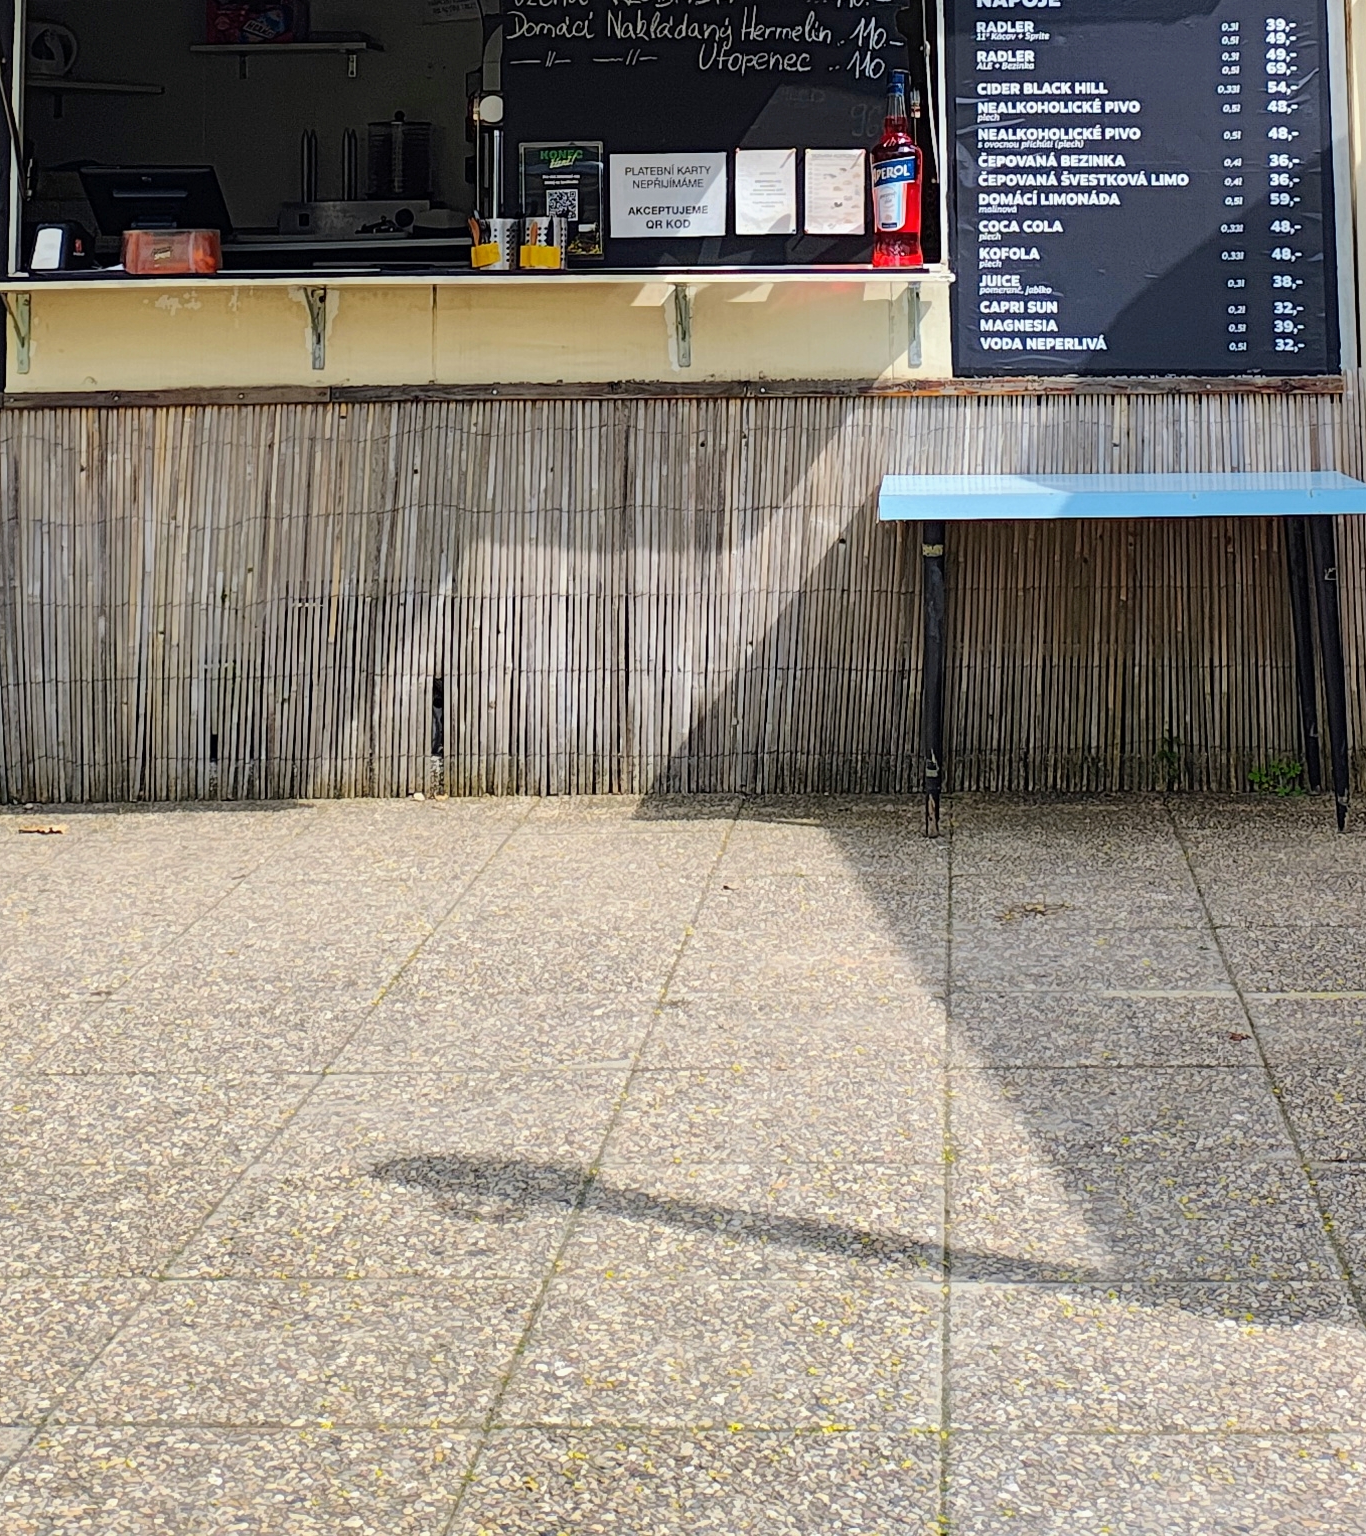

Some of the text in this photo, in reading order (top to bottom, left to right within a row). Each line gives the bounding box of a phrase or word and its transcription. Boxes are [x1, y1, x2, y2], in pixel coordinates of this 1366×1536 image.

[507, 11, 594, 39] Domácí
[607, 9, 732, 49] Nakládaný
[976, 18, 1296, 32] RADLER 39,-
[1266, 32, 1296, 46] 49,-
[699, 40, 811, 76] Utopenec
[977, 49, 1297, 62] RADLER 49,-
[1266, 63, 1297, 76] 69,-
[977, 81, 1297, 95] CIDER BLACK HILL 54,-
[977, 99, 1298, 114] NEALKOHOLICKÉ PIVO 48,-
[978, 125, 1299, 141] NEALKOHOLICKÉ PIVO 48,-
[978, 152, 1300, 169] ČEPOVANÁ BEZINKA 36,-
[625, 164, 711, 175] PLATEBNÍ KARTY
[633, 178, 704, 188] NEPŘIJÍMÁME
[978, 172, 1300, 187] ČEPOVANÁ ŠVESTKOVÁ LIMO 36,-
[978, 191, 1300, 207] DOMÁCÍ LIMONÁDA 59,-
[628, 205, 708, 216] AKCEPTUJEME
[646, 219, 690, 229] QR KOD
[979, 220, 1301, 234] COCA COLA 48,-
[979, 248, 1302, 262] KOFOLA 48,-
[979, 275, 1303, 289] JUICE 38,-
[980, 301, 1304, 315] CAPRI SUN 32,-
[980, 319, 1304, 334] MAGNESIA 39,-
[980, 335, 1305, 352] VODA NEPERLIVÁ 32,-
